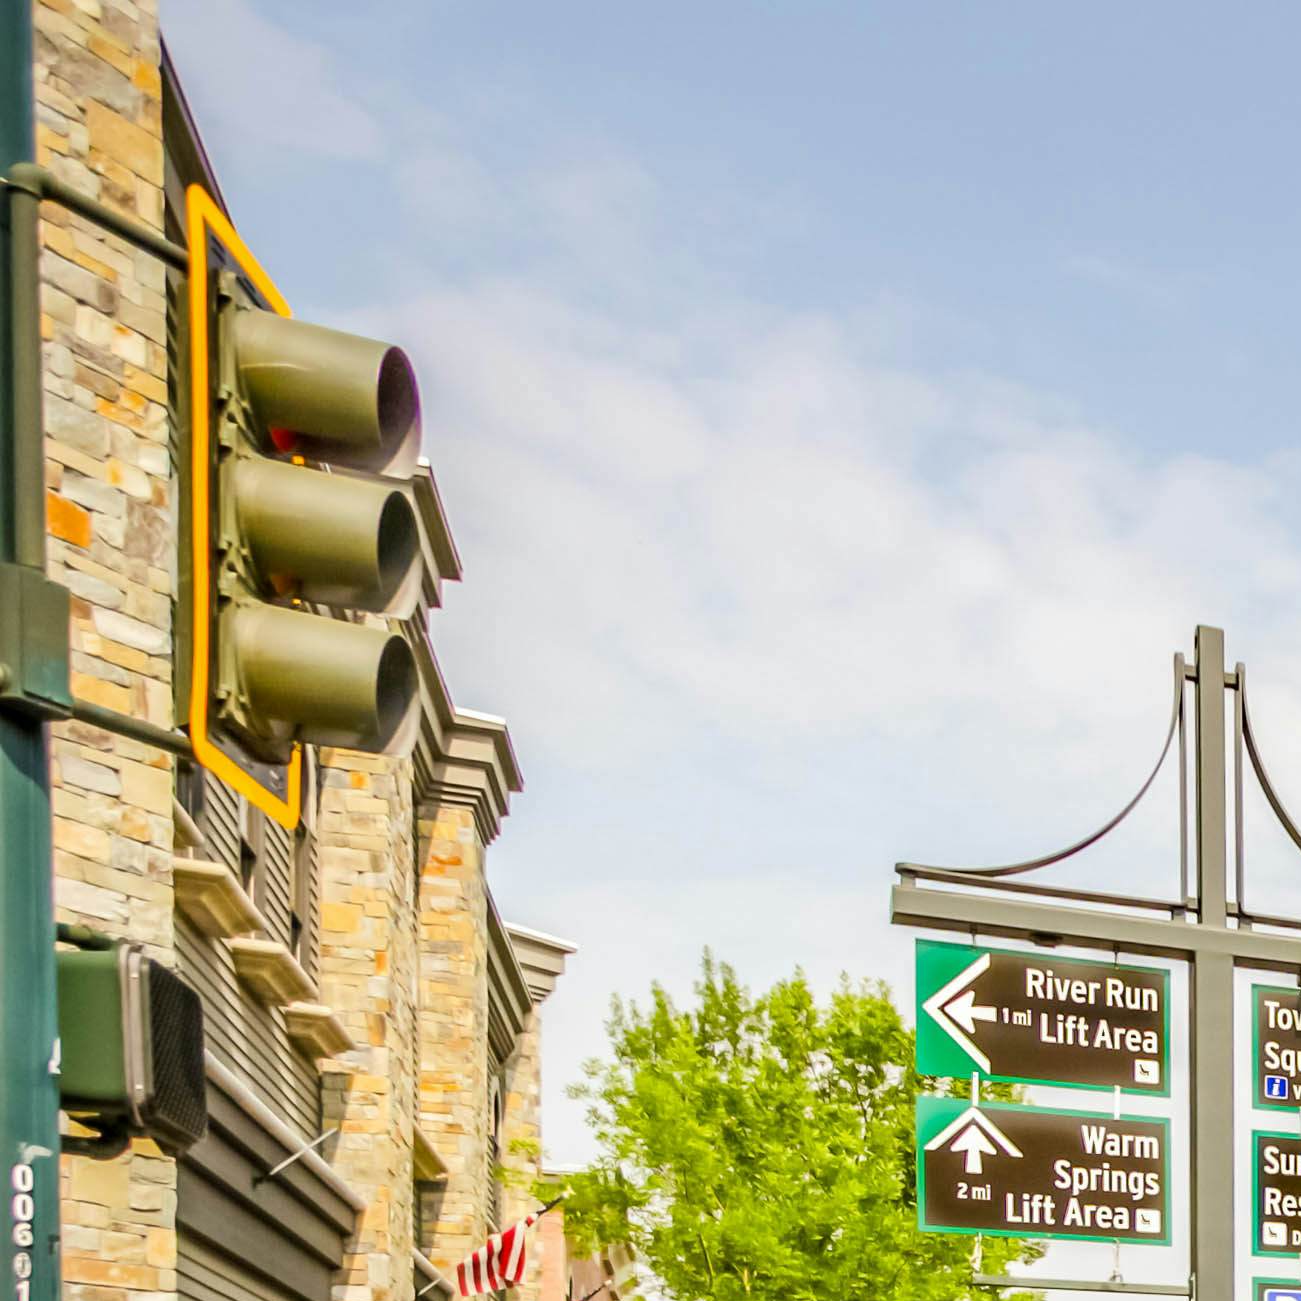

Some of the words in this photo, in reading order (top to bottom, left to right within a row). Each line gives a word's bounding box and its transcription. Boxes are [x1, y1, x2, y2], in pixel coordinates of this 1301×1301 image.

[1026, 967, 1101, 1005] River
[1105, 977, 1159, 1012] Run
[1002, 1007, 1009, 1024] 1
[1012, 1009, 1032, 1027] mi
[1040, 1012, 1089, 1047] Lift
[1093, 1019, 1159, 1054] Area
[1081, 1124, 1159, 1159] Warm
[956, 1182, 968, 1199] 2
[972, 1184, 991, 1201] mi
[1053, 1159, 1160, 1200] Springs
[1006, 1193, 1056, 1225] Lift
[1063, 1197, 1130, 1230] Area
